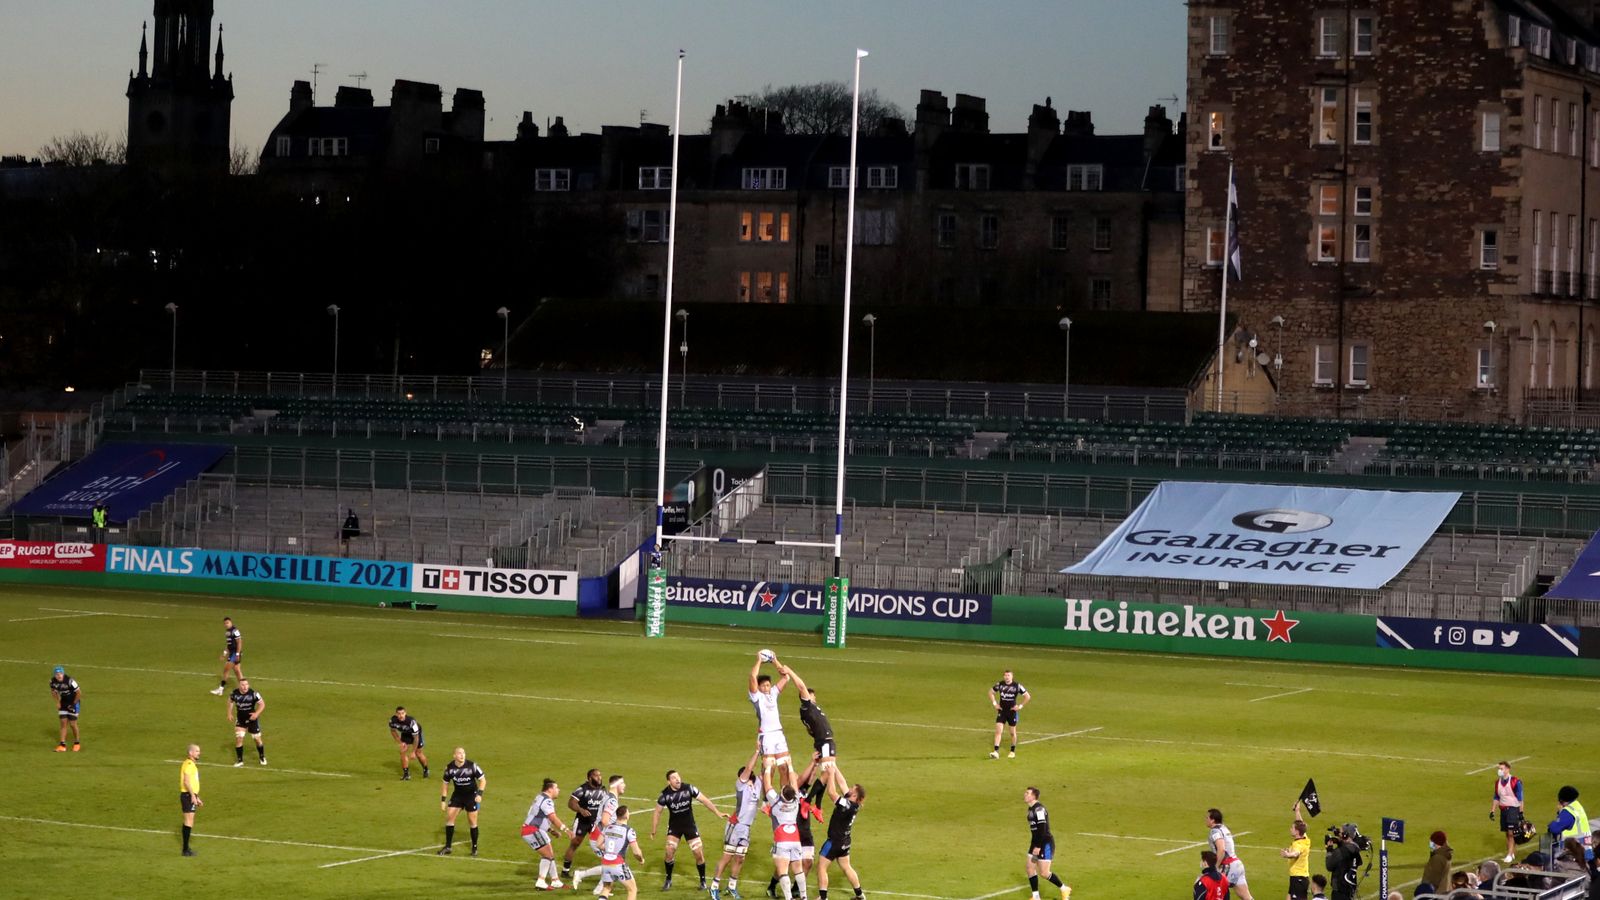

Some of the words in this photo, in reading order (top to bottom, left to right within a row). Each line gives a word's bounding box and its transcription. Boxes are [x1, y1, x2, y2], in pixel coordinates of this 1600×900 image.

[82, 476, 143, 489] BATH
[58, 491, 120, 501] RUGBY
[17, 546, 53, 556] RUGBY
[57, 545, 86, 554] CLEAN
[1125, 530, 1400, 557] Gallagher
[110, 547, 193, 574] FINALS
[202, 554, 342, 582] MARSEILLE
[350, 562, 408, 588] 2021
[1126, 552, 1356, 573] INSURANCE
[424, 569, 440, 588] T
[464, 571, 567, 595] TISSOT
[650, 586, 662, 634] Heineken
[666, 582, 745, 605] eineken
[791, 590, 926, 616] CHMPIONS
[932, 598, 979, 618] CUP
[827, 595, 838, 644] Heineken
[1064, 598, 1257, 641] Heineken
[670, 800, 690, 810] dyson
[608, 840, 615, 852] 9
